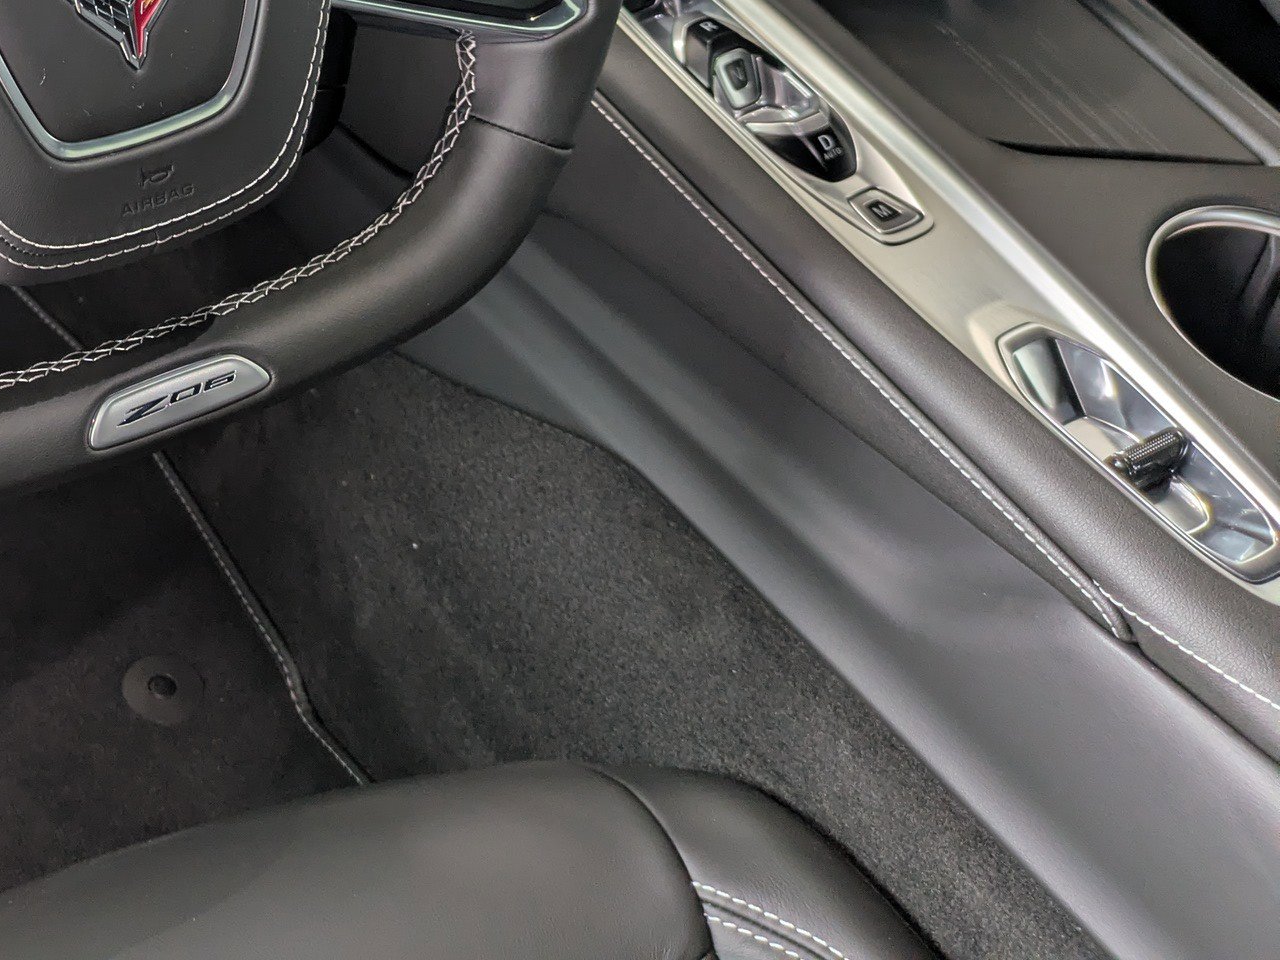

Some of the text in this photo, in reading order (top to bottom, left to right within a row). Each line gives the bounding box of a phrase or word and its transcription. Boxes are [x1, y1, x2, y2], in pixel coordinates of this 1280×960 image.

[699, 21, 719, 32] R
[817, 134, 836, 151] D
[121, 183, 196, 217] AIRBAG
[872, 204, 890, 218] M
[116, 370, 238, 427] Z06
